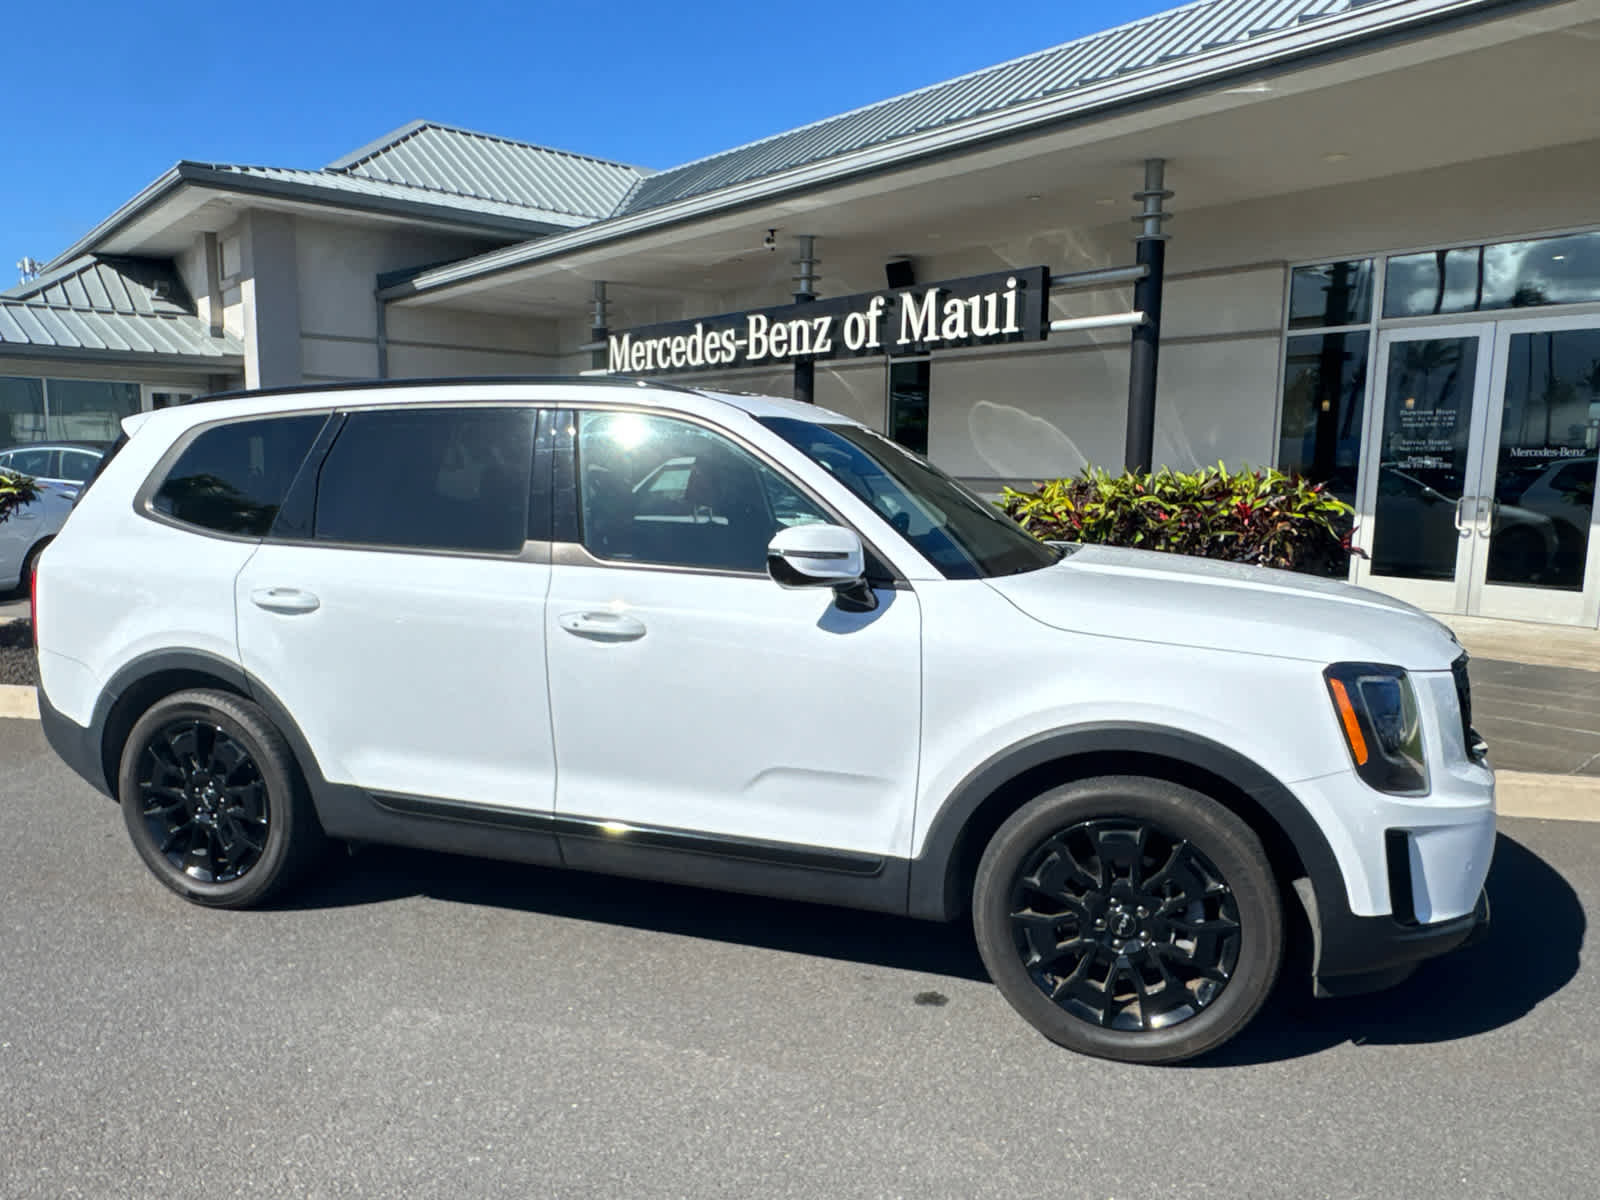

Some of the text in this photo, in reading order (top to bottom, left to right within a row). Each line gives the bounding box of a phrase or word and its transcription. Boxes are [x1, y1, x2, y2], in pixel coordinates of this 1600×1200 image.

[608, 276, 1020, 373] Mercedes-Benz of Maui
[1510, 447, 1586, 457] Mercedes-Benz
